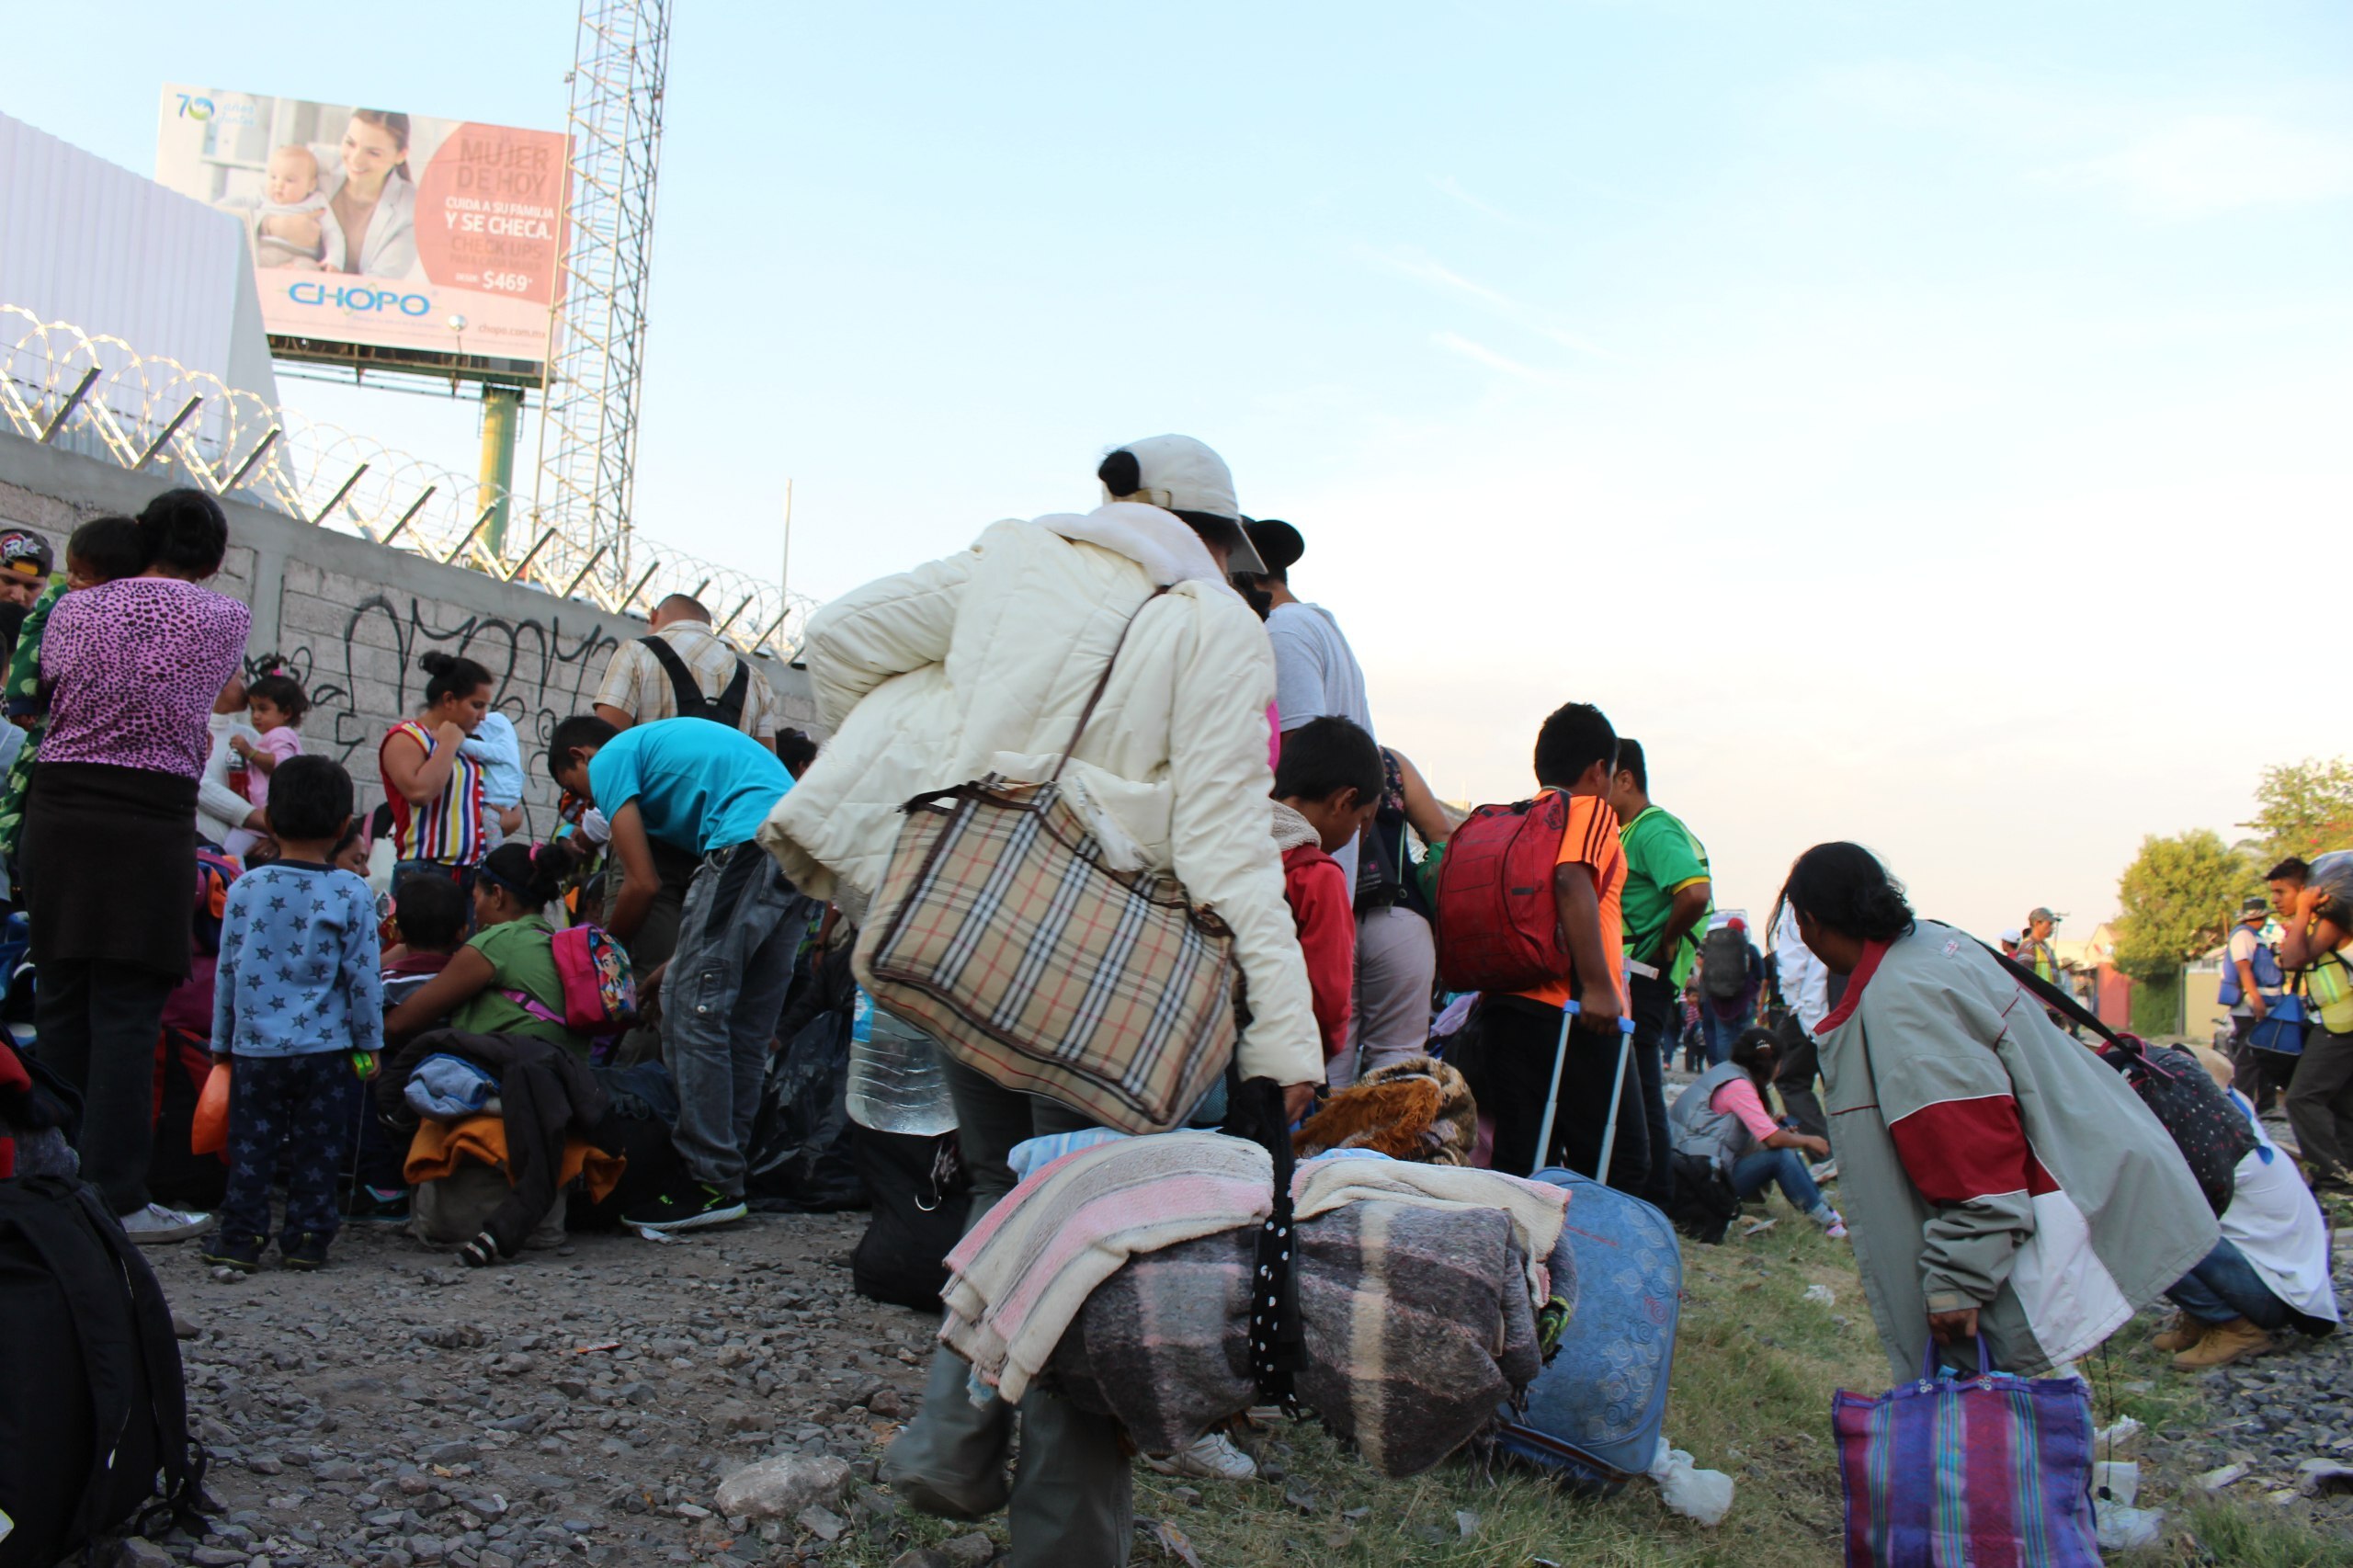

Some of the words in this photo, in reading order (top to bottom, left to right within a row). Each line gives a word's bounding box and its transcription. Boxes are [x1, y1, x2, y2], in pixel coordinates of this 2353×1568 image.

[460, 139, 549, 170] MUJER
[458, 165, 490, 191] DE
[496, 169, 548, 196] HOY
[445, 196, 481, 210] CUIDA
[482, 200, 491, 212] A
[493, 201, 508, 214] SU
[510, 203, 555, 220] FAMILIA
[445, 210, 458, 230] Y
[460, 212, 485, 233] SE
[487, 216, 553, 241] CHECA.
[451, 236, 506, 256] CHECK
[510, 241, 544, 260] UPS
[289, 282, 430, 316] CHOPO
